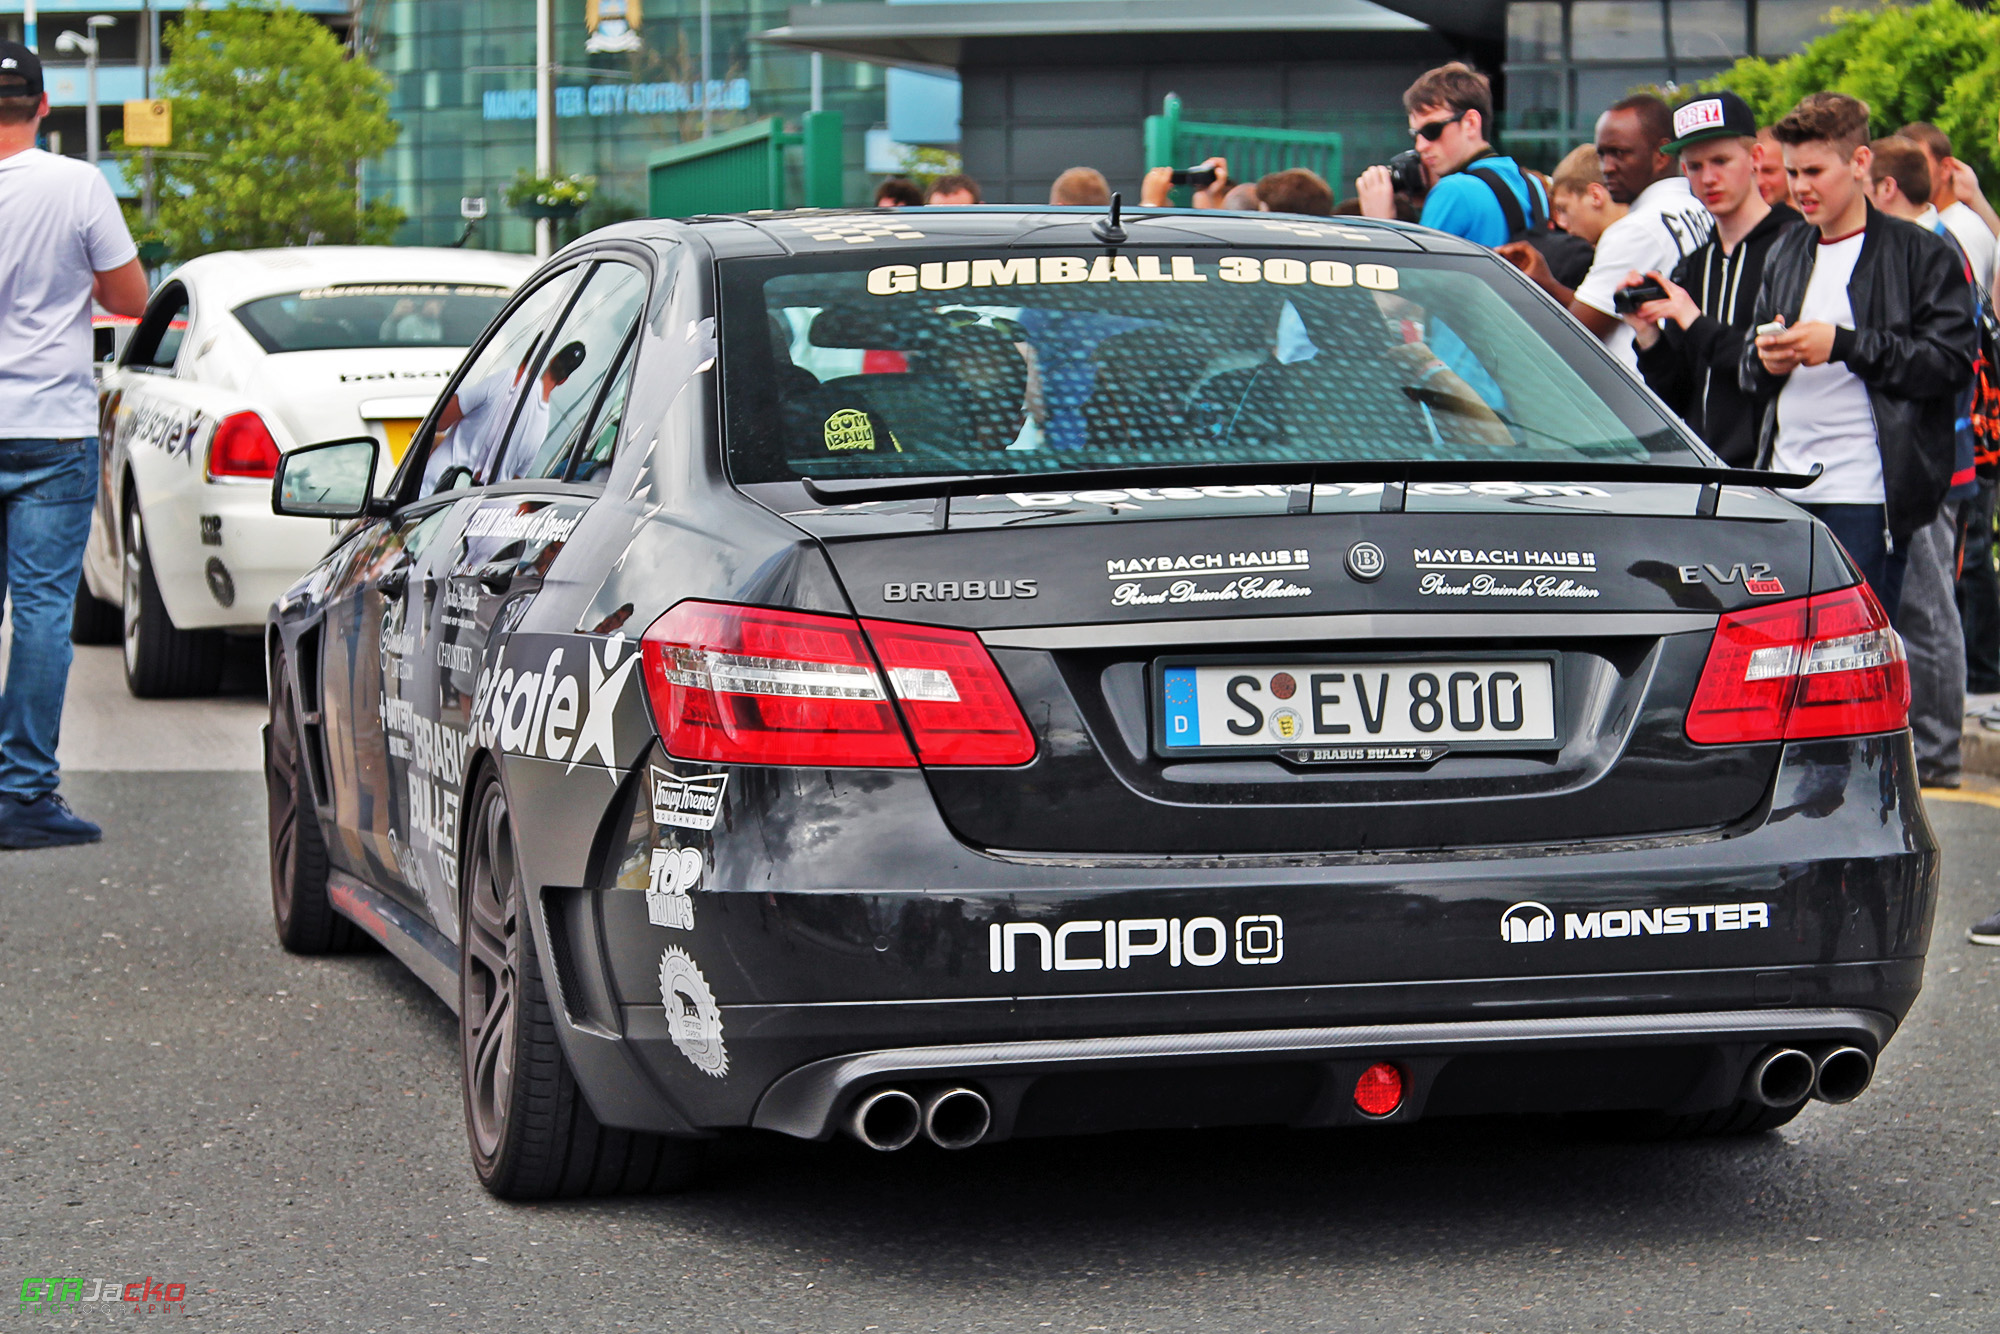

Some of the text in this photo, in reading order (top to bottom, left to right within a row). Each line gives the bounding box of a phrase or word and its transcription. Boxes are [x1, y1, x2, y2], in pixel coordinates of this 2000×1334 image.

[588, 84, 626, 116] CITY
[705, 77, 751, 111] CLUB
[1678, 103, 1720, 131] OBEY
[867, 255, 1399, 296] GUMBALL 3000
[534, 509, 583, 549] Speed
[1107, 549, 1293, 574] MAYBACH HAUS
[1413, 548, 1580, 566] MAYBACH HAUS
[883, 579, 1039, 602] BRABUS
[1111, 576, 1313, 606] Privat Daimler Collection
[1418, 572, 1600, 598] Privat Daimler Collection
[1751, 583, 1780, 593] 800
[1226, 675, 1265, 736] S
[1309, 672, 1390, 735] EV
[1408, 671, 1525, 733] 800
[1175, 715, 1189, 733] D
[1313, 748, 1417, 760] BRABUS BULLET
[680, 783, 719, 811] Kreme
[656, 812, 710, 827] DOUGHNUTS
[649, 848, 703, 896] TOP
[646, 889, 695, 931] TRUMPS
[1564, 902, 1769, 940] MONSTER
[989, 916, 1227, 973] INCIPIO
